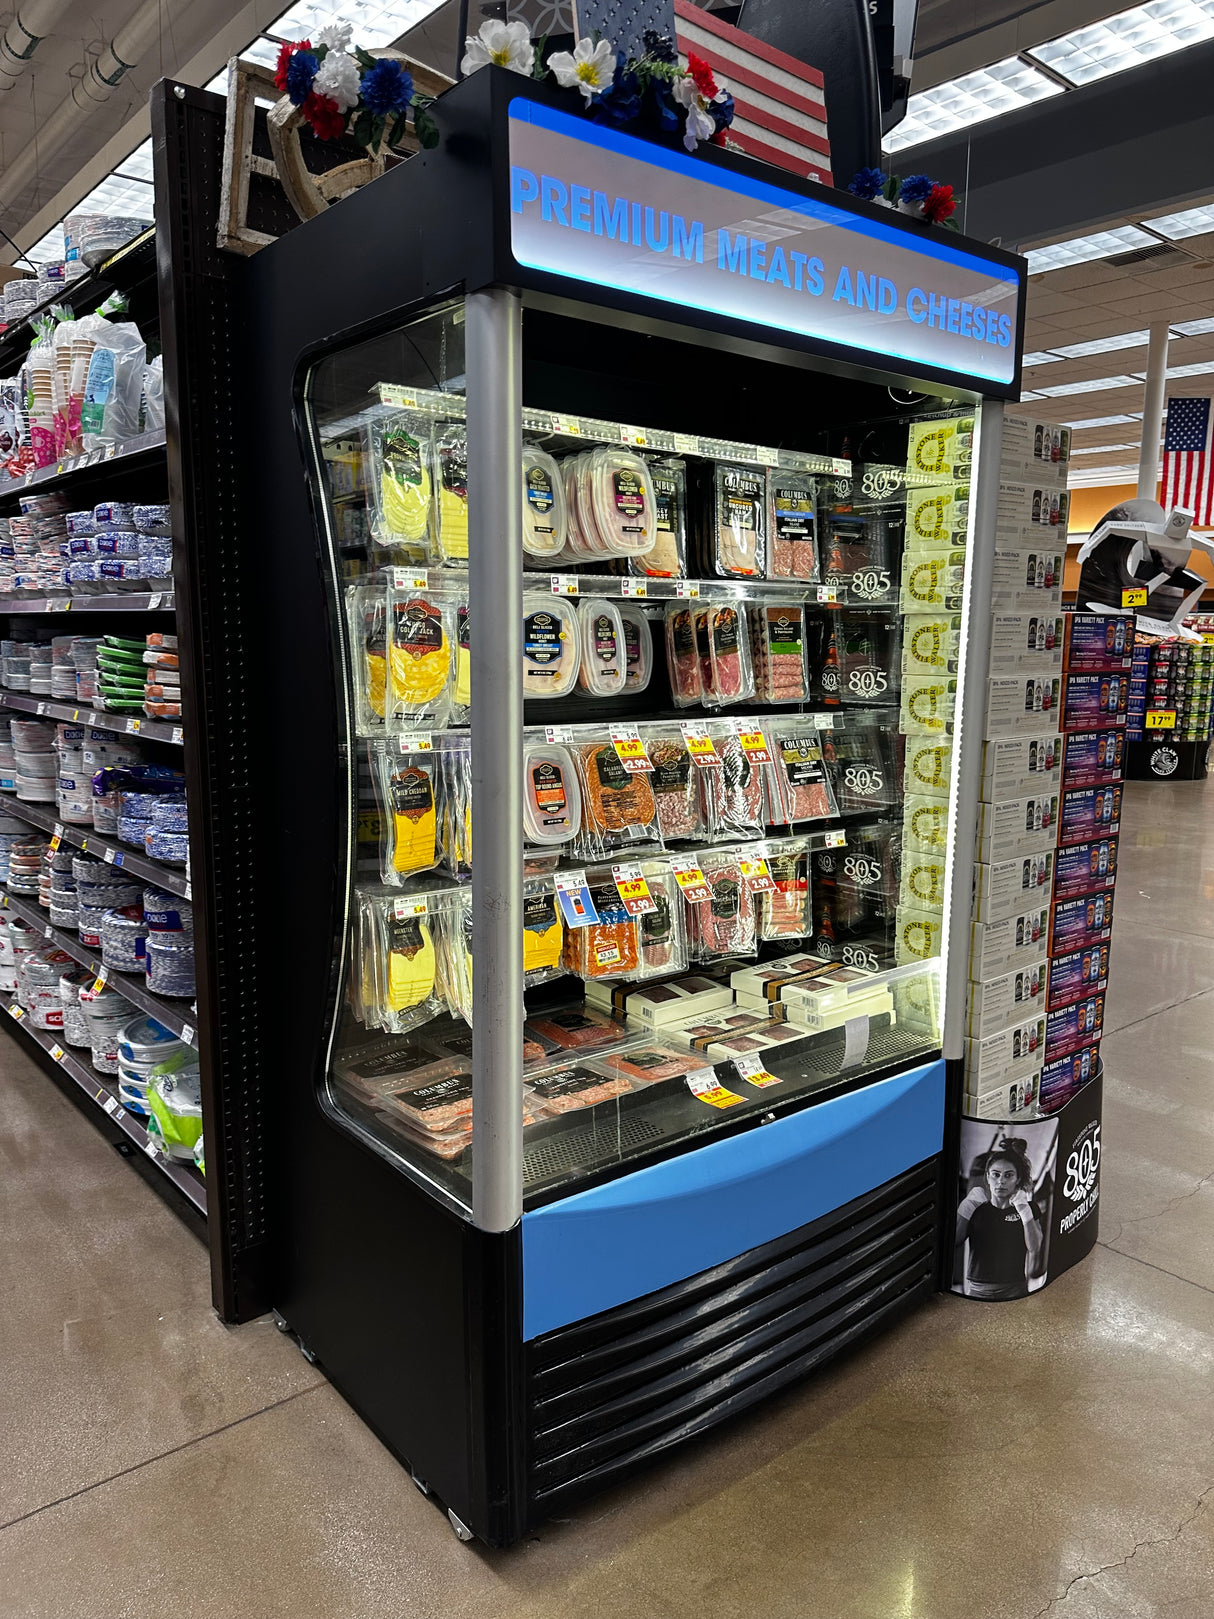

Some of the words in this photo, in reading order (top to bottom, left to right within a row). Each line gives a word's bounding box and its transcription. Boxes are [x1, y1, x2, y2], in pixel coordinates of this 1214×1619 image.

[511, 166, 704, 265] PREMIUM
[717, 229, 825, 297] MEATS
[833, 266, 898, 315] AND
[906, 288, 1012, 348] CHEESES
[916, 433, 938, 473] FIRESTONE
[936, 430, 945, 473] WALKER
[861, 470, 901, 494] 805
[780, 489, 808, 500] COLUMBUS
[914, 499, 936, 538] FIRESTONE
[933, 499, 943, 539] WALKER
[414, 580, 427, 588] 5.49
[851, 572, 891, 594] 805
[909, 563, 929, 601] FIRESTONE
[928, 563, 938, 602] WALKER
[530, 633, 556, 641] WILDFLOWER
[911, 626, 931, 663] FIRESTONE
[930, 626, 940, 664] WALKER
[821, 673, 841, 686] 805
[848, 671, 888, 692] 805
[418, 742, 431, 750] 5.49
[691, 740, 707, 748] 4.99
[745, 736, 760, 745] 4.99
[784, 739, 817, 750] COLUMBUS
[621, 743, 638, 752] 4.99
[699, 756, 715, 764] 2.99
[750, 751, 767, 761] 2.99
[1150, 748, 1163, 766] WHITE
[1161, 746, 1178, 758] CLAW
[628, 759, 646, 769] 2.99
[932, 748, 942, 785] WALKER
[844, 768, 884, 791] 805
[630, 871, 642, 879] 5.99
[843, 857, 882, 881] 805
[573, 879, 585, 887] 5.49
[681, 872, 698, 882] 4.99
[624, 883, 641, 894] 4.99
[752, 878, 769, 889] 2.99
[928, 866, 938, 904] WALKER
[566, 889, 582, 897] NEW
[688, 888, 708, 899] 2.99
[414, 905, 426, 914] 5.49
[630, 900, 649, 912] 2.99
[1063, 902, 1076, 910] VARIETY
[903, 922, 923, 956] FIRESTONE
[842, 946, 879, 972] 805
[1059, 956, 1072, 965] VARIETY
[1072, 953, 1081, 961] PACK
[1054, 1008, 1068, 1017] VARIETY
[1067, 1005, 1076, 1013] PACK
[364, 1050, 409, 1067] COLUMBUS
[1049, 1060, 1062, 1071] VARIETY
[1062, 1056, 1071, 1065] PACK
[534, 1070, 576, 1086] COLUMBUS
[747, 1072, 771, 1083] 13.49
[413, 1077, 461, 1097] COLUMBUS
[1063, 1125, 1101, 1198] 805
[1060, 1198, 1089, 1235] PROPERLY
